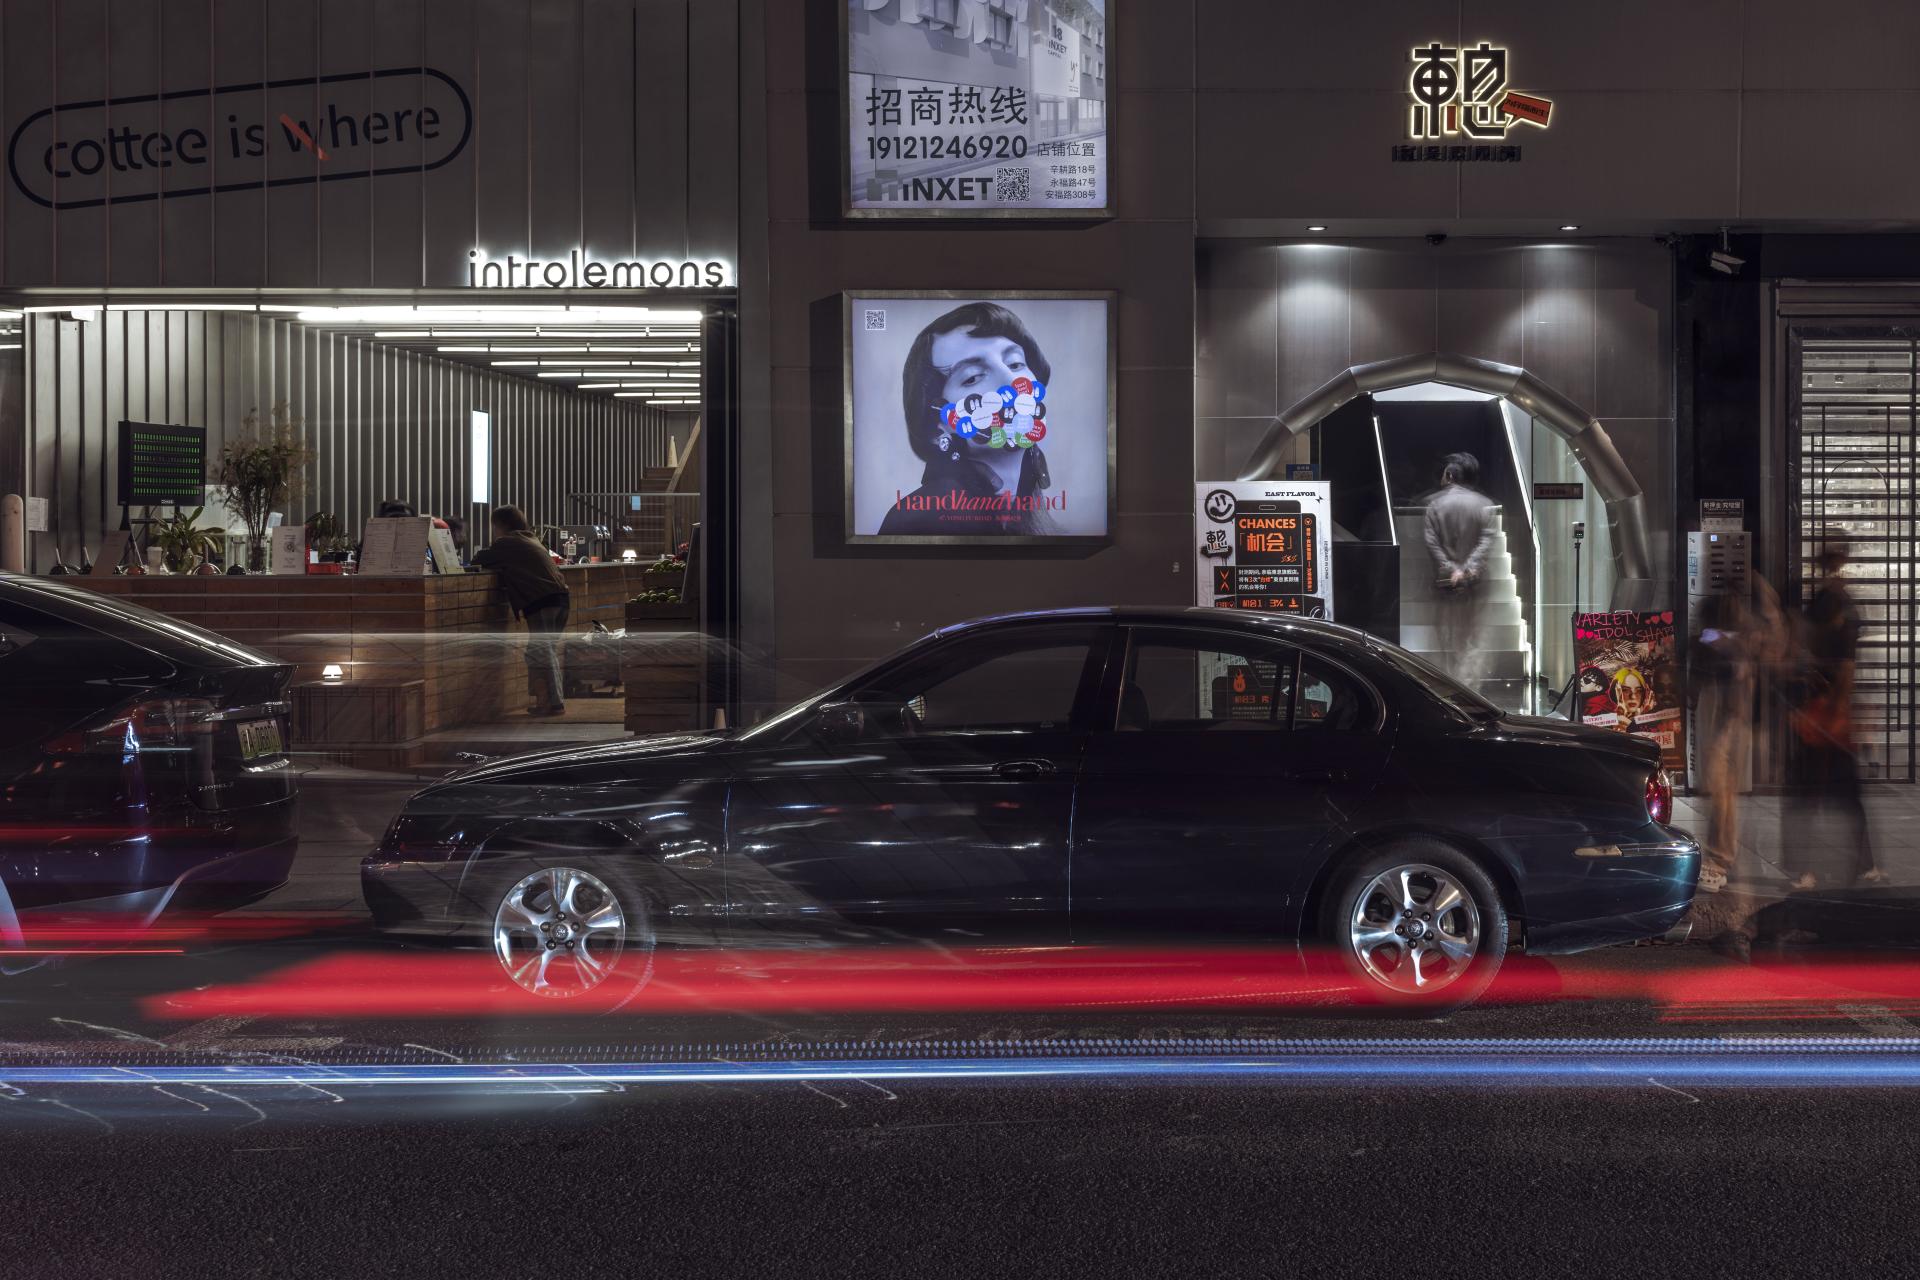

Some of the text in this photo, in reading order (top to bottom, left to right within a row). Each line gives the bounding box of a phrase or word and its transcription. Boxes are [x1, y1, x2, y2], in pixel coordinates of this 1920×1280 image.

[866, 86, 1028, 126] 招商热线
[228, 115, 269, 158] is
[281, 104, 440, 155] where
[867, 135, 1028, 159] 19121246920
[1037, 143, 1097, 157] 店铺位置
[1050, 165, 1097, 175] 辛耕路18号
[1050, 178, 1097, 188] 永福路47号
[1044, 190, 1097, 200] 安福路308号
[469, 250, 725, 287] introlemons
[1239, 518, 1296, 529] CHANCES
[1576, 612, 1640, 626] VARIETY
[1594, 627, 1633, 640] IDOL
